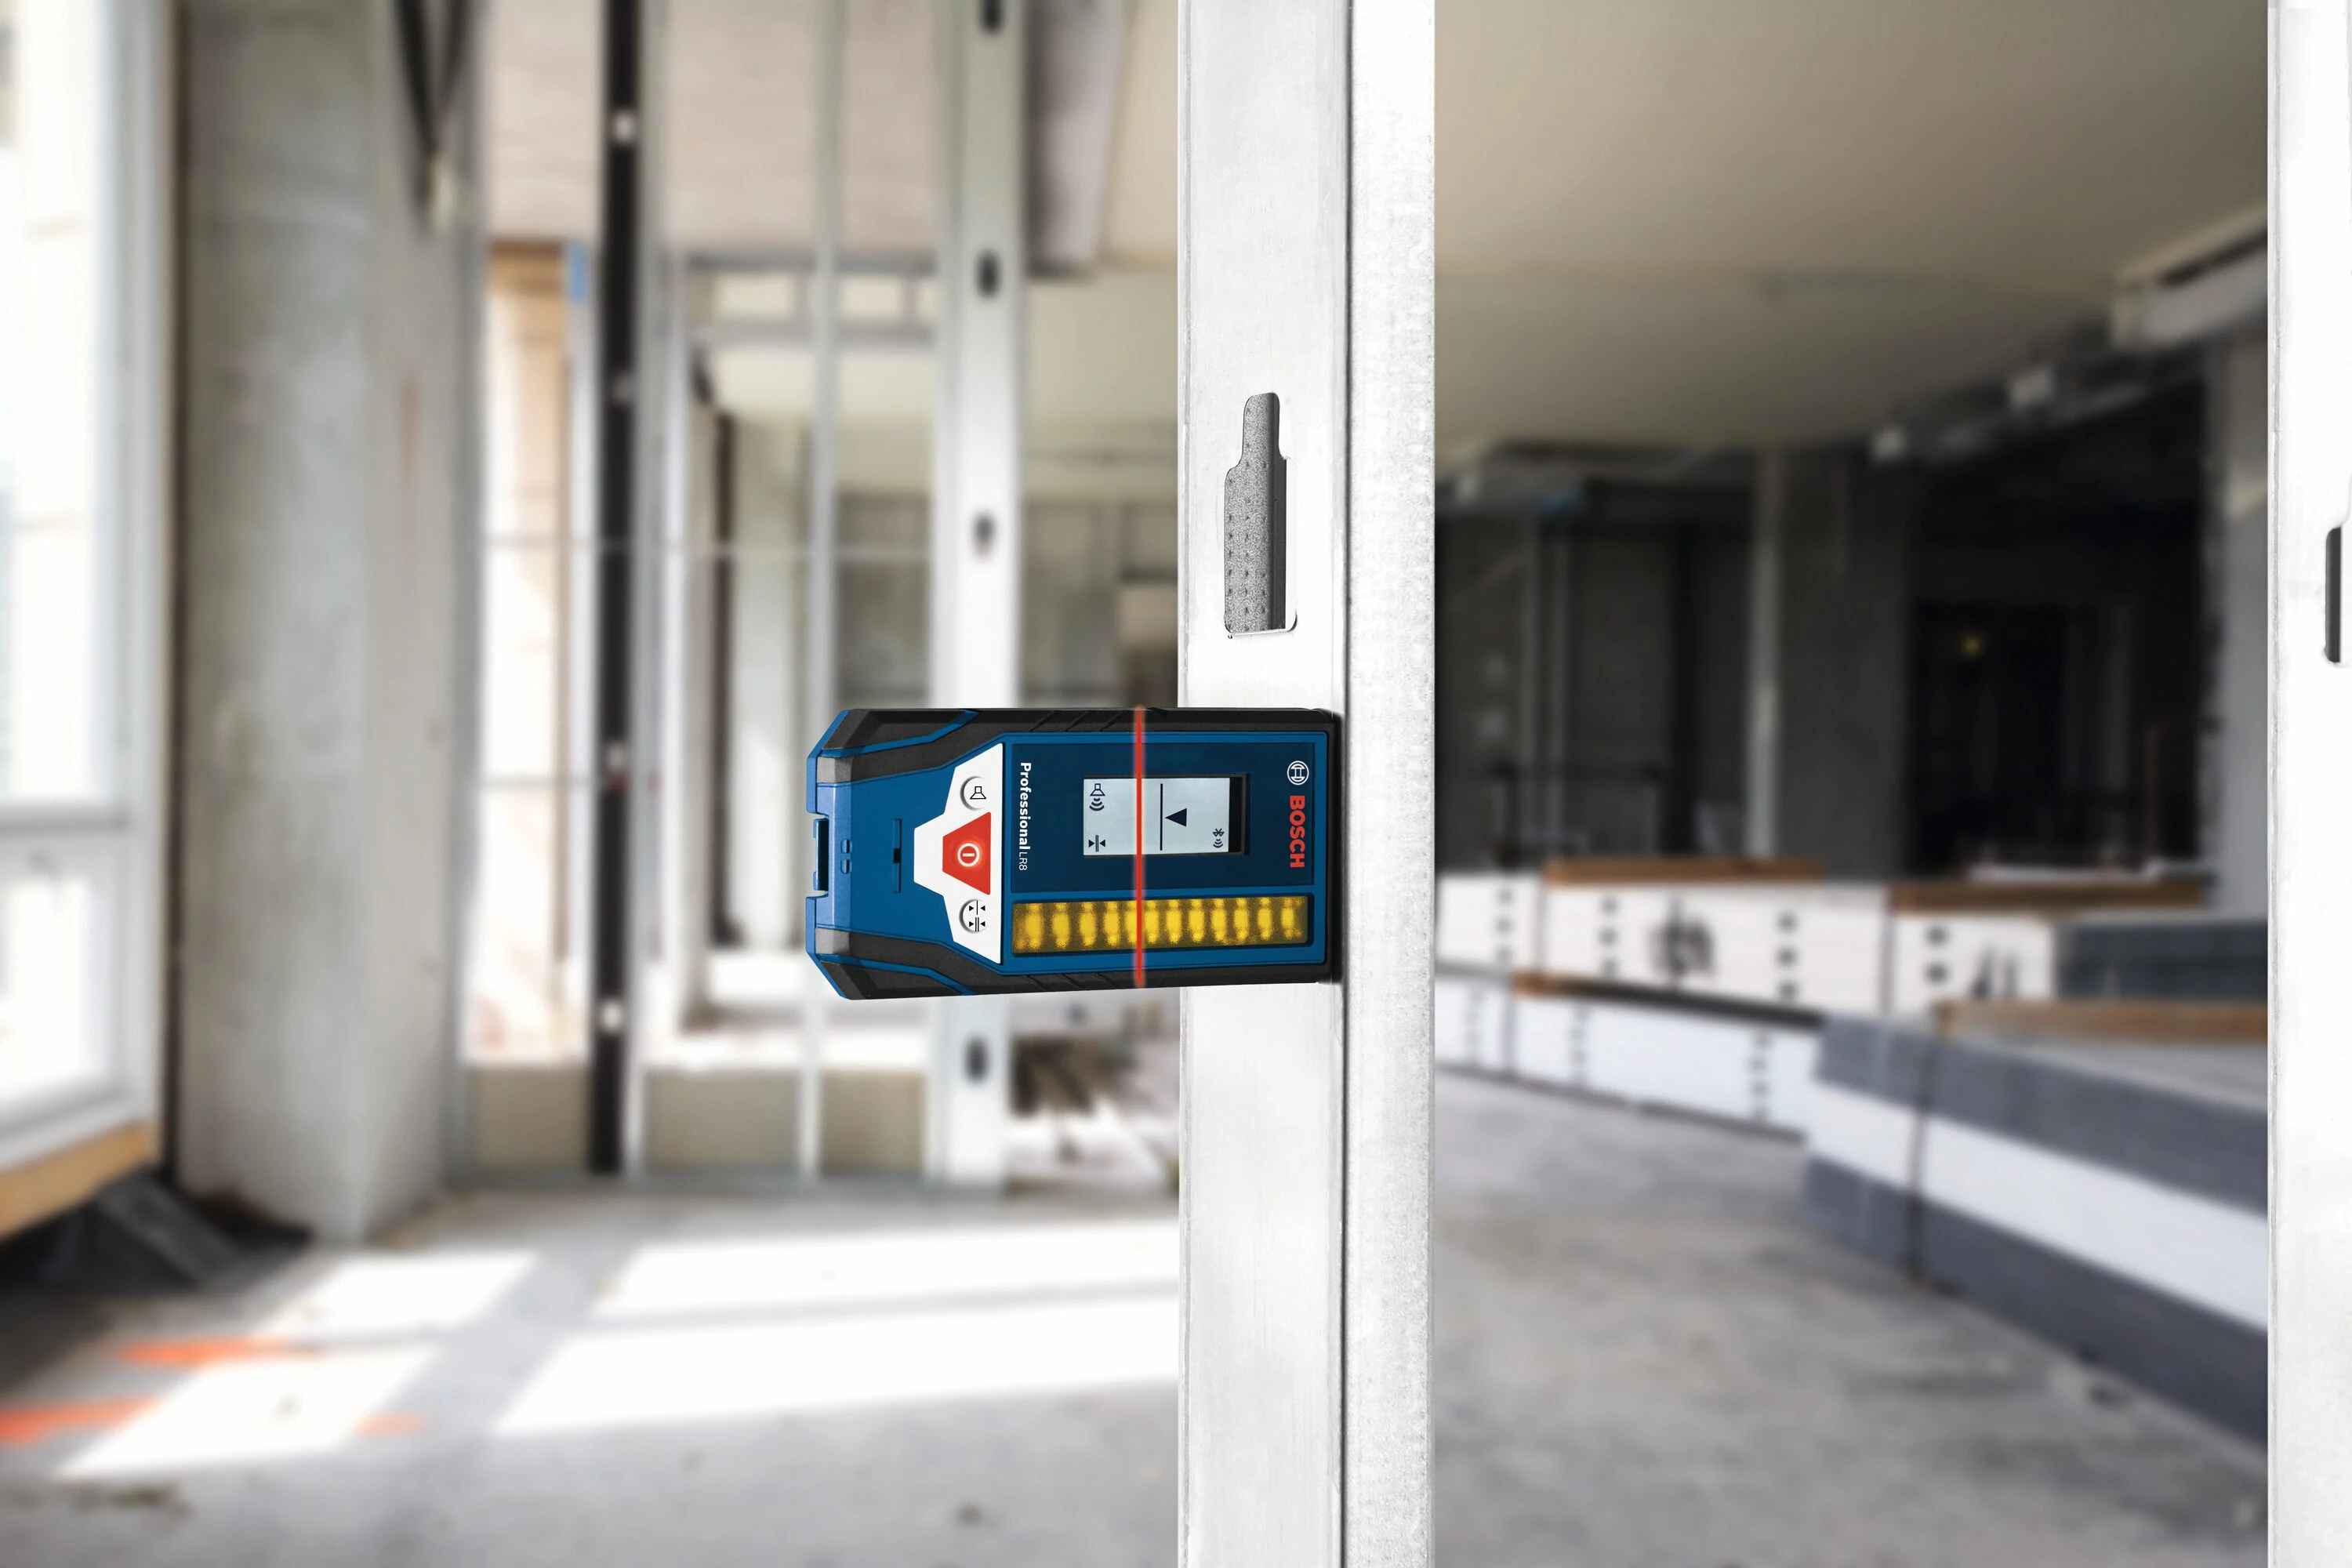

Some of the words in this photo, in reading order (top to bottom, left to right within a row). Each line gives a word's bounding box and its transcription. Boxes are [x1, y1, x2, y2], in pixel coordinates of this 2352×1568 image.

[1019, 762, 1032, 850] Professional
[1289, 795, 1305, 868] BOSCH
[1018, 851, 1028, 871] LR8
